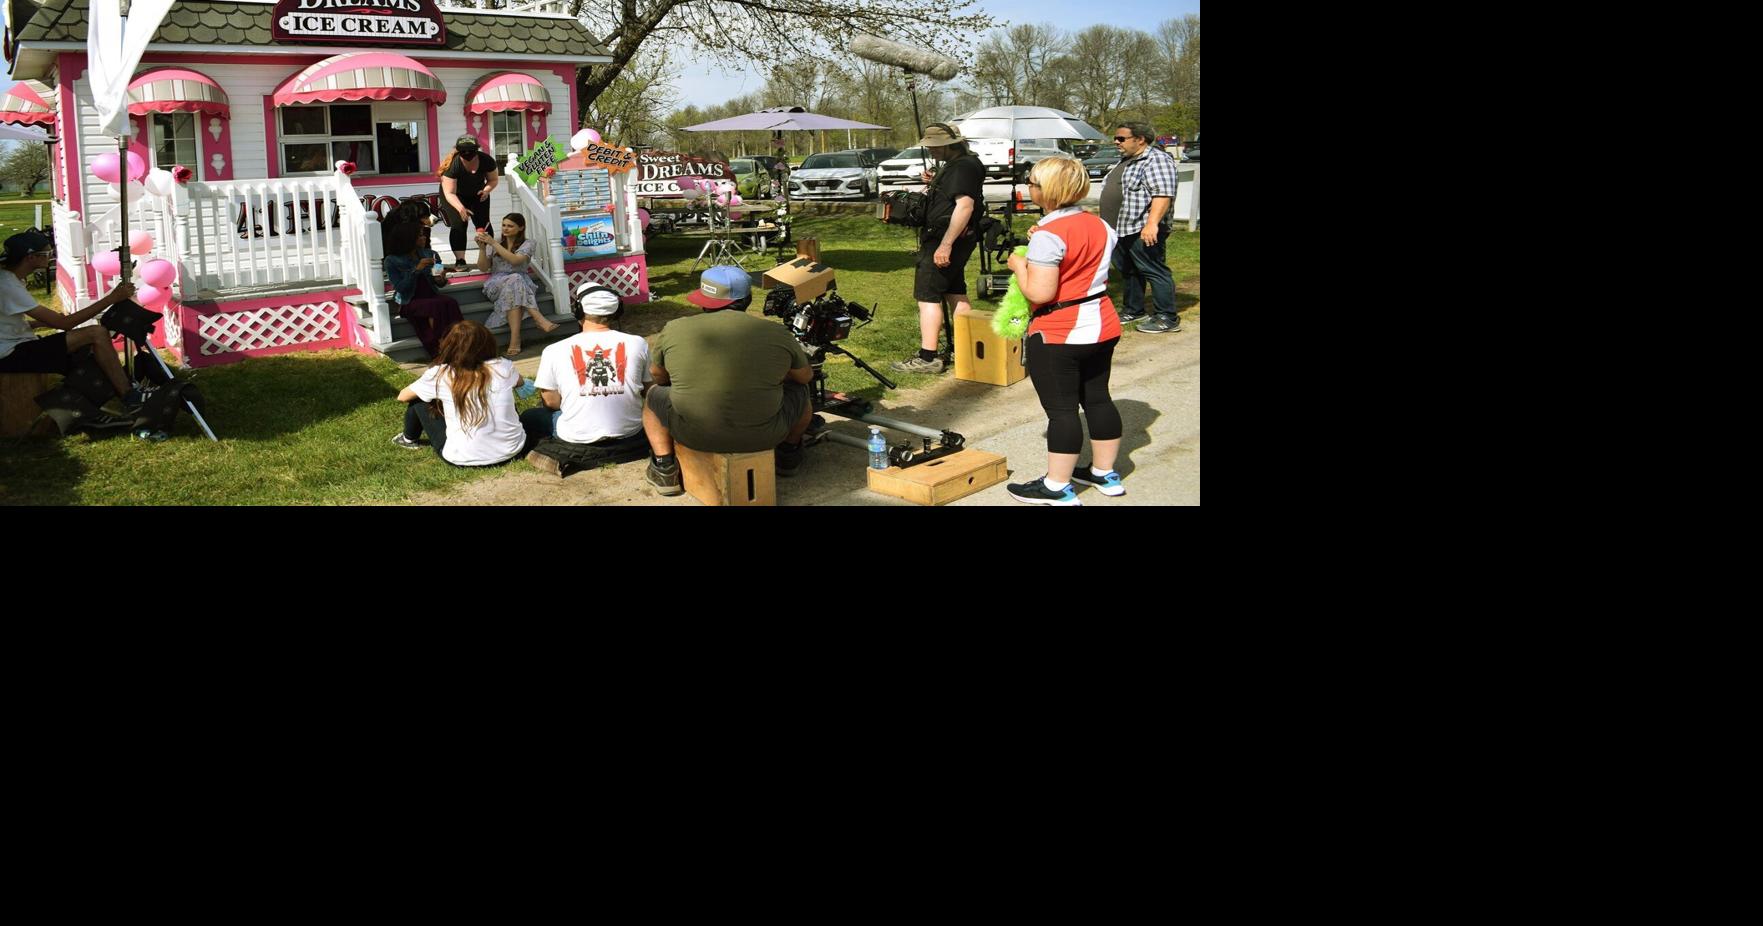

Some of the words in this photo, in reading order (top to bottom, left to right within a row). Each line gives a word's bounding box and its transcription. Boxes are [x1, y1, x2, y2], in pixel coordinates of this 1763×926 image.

[293, 16, 335, 32] ICE
[341, 17, 427, 35] CREAM
[518, 145, 545, 171] VEGAN
[526, 146, 555, 175] GLUTEN
[587, 143, 622, 158] DEBIT
[623, 151, 632, 160] &
[588, 153, 629, 168] CREDIT
[640, 153, 680, 163] Sweet
[642, 162, 724, 181] DREAMS
[638, 182, 665, 193] ICE
